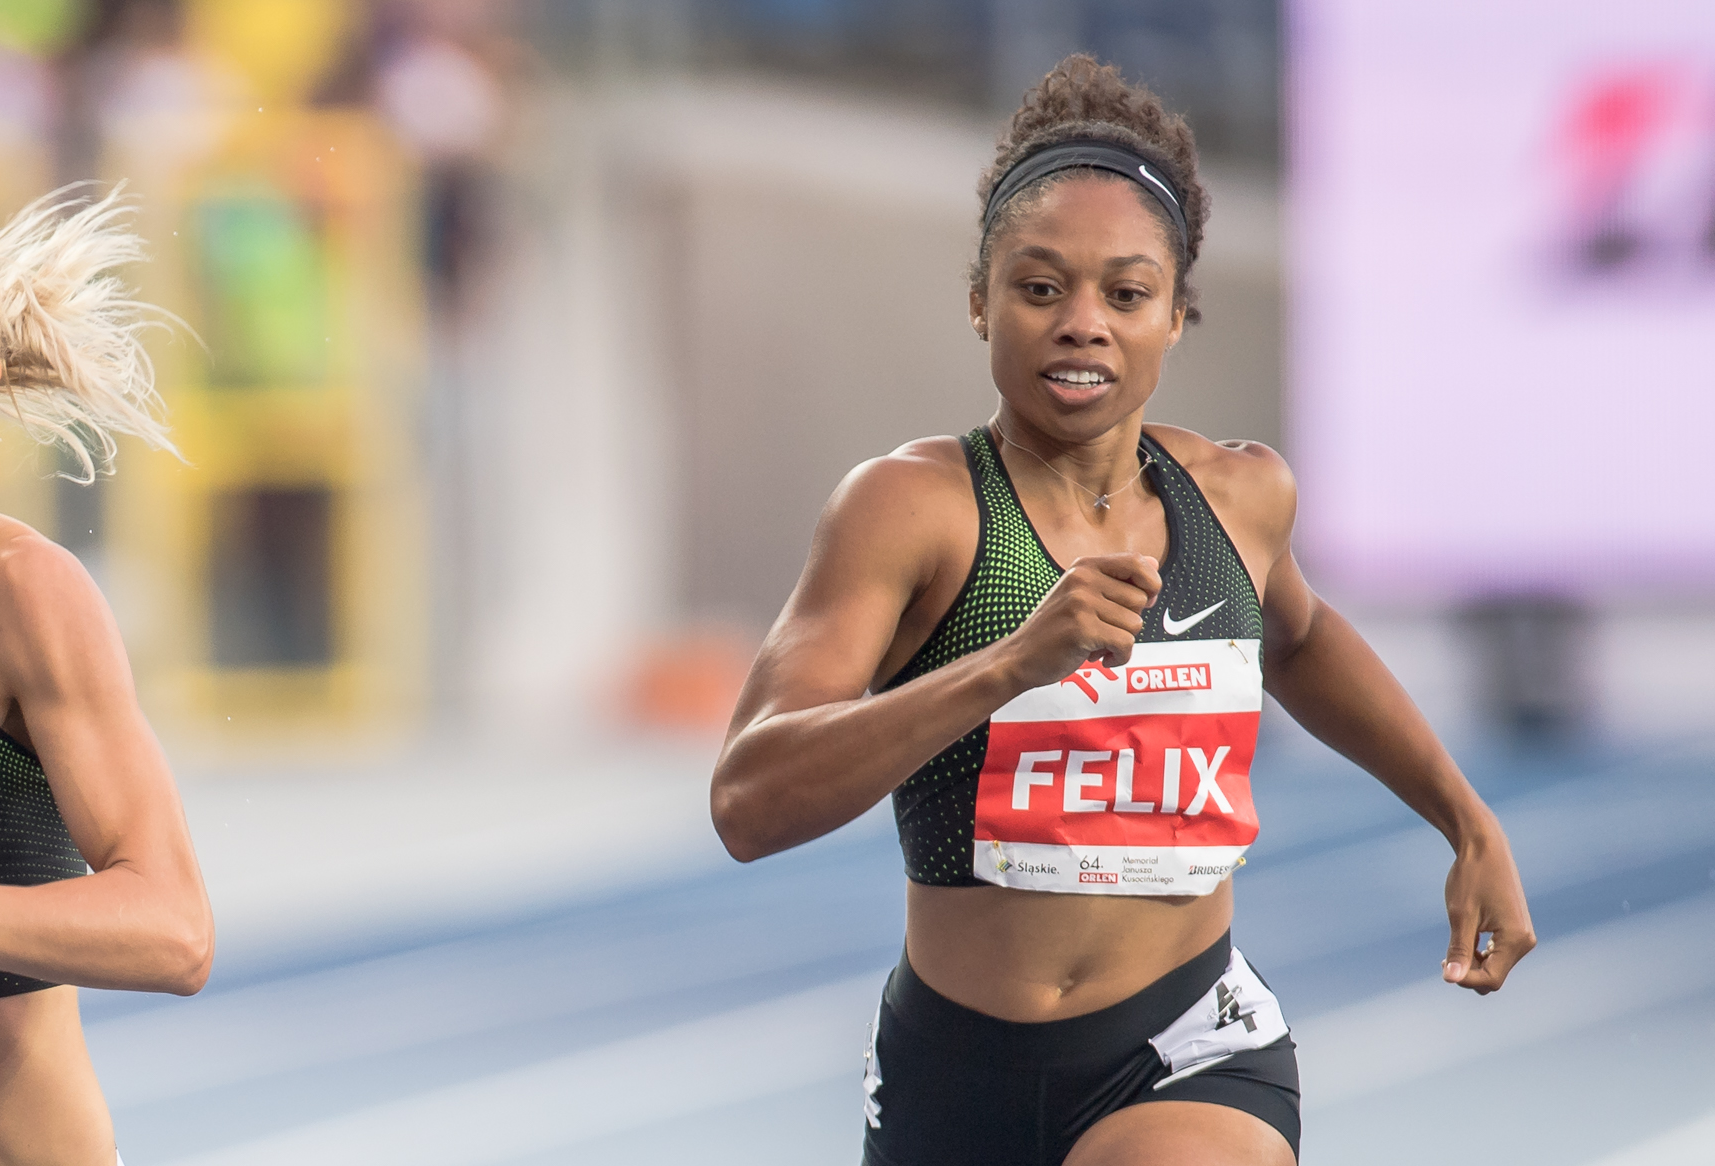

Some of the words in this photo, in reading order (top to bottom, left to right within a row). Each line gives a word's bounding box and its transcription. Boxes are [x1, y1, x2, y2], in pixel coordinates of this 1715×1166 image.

[1130, 666, 1208, 690] ORLEN
[1011, 745, 1235, 816] FELIX
[1079, 855, 1104, 870] 64.
[1122, 866, 1153, 874] Janusza
[1080, 873, 1117, 882] ORLEN
[1215, 980, 1258, 1034] 4
